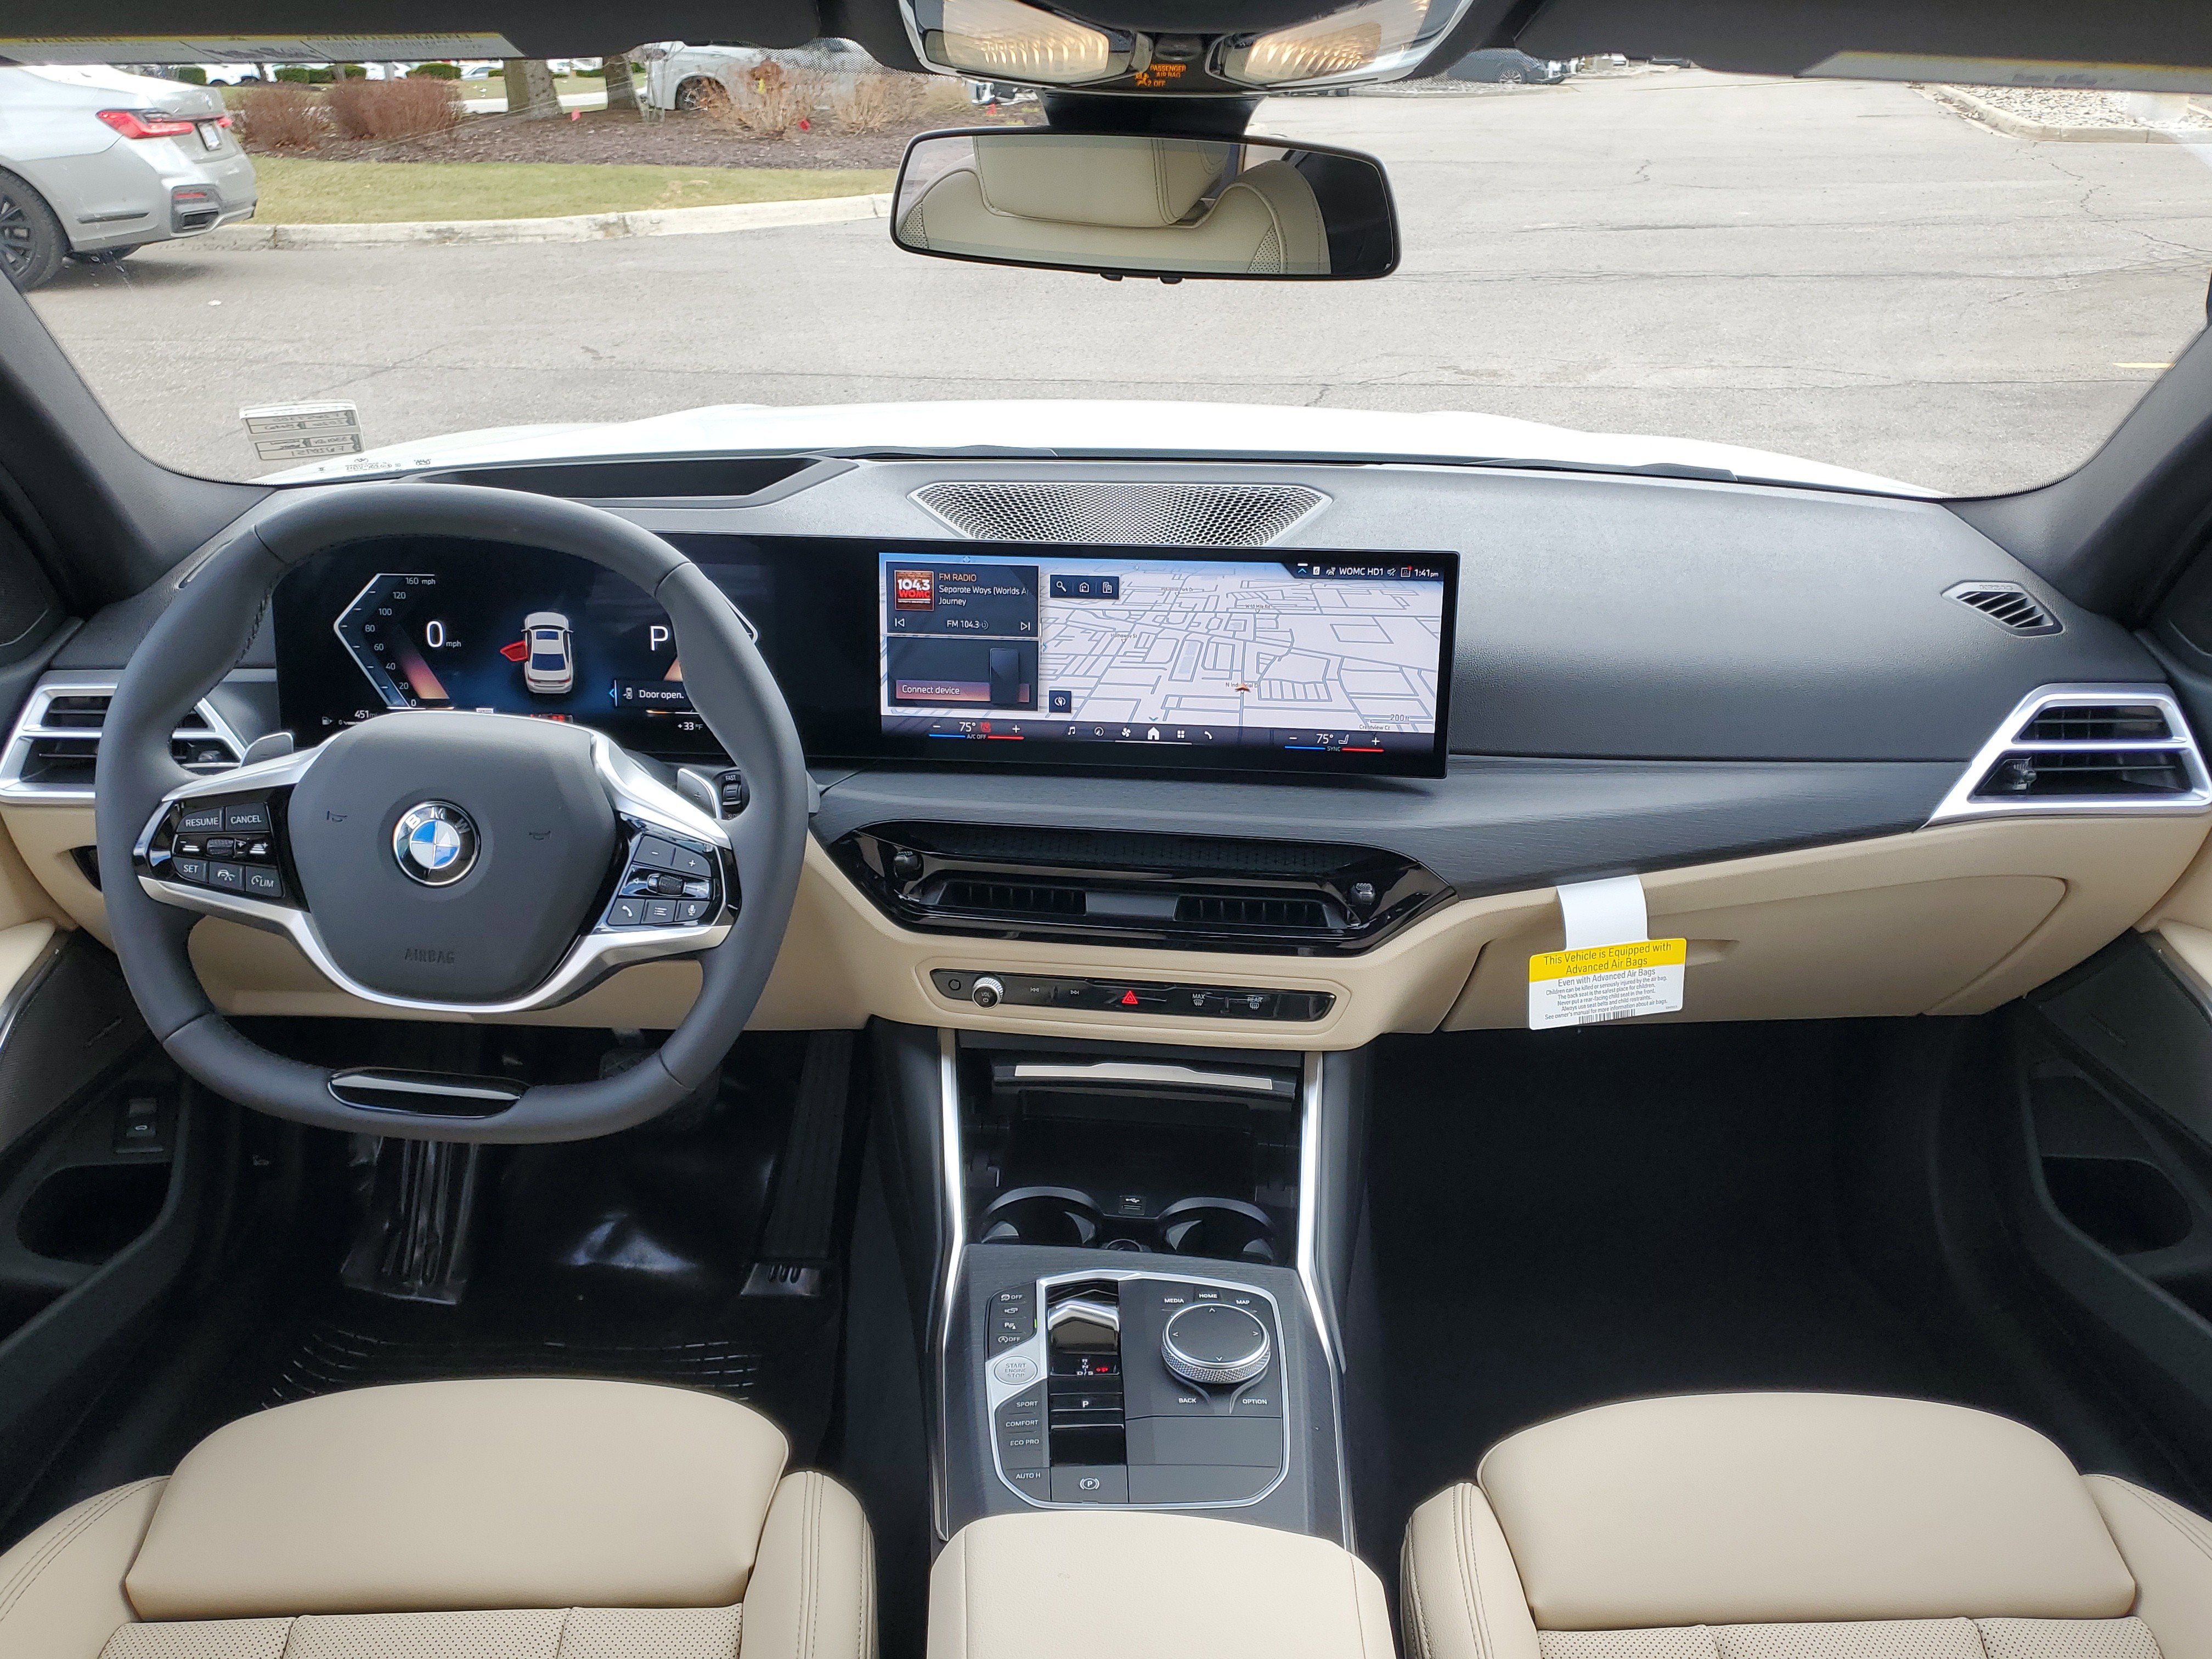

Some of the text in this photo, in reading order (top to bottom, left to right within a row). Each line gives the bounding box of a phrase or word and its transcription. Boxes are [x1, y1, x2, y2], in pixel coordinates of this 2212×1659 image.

[1339, 567, 1383, 576] WOMC HD1
[952, 574, 977, 582] RADIO
[898, 579, 930, 591] 104.3
[898, 589, 930, 598] WOMC
[939, 585, 970, 594] Separate
[972, 586, 992, 595] Ways
[993, 587, 1020, 596] (Worlds
[939, 597, 967, 606] Journey
[960, 620, 979, 629] 104.3
[426, 620, 462, 649] 0 mph
[650, 625, 669, 651] P
[374, 643, 384, 651] 60
[902, 685, 960, 695] Connect device
[639, 690, 684, 701] Door open.
[411, 698, 417, 707] 0
[354, 710, 369, 719] 451
[959, 721, 977, 732] 75°
[1316, 733, 1334, 744] 75°
[185, 815, 262, 827] RESUME CANCEL
[405, 806, 471, 834] BMW
[183, 864, 199, 873] SET
[259, 878, 274, 888] LIM
[404, 948, 455, 963] AIRBAG
[1544, 942, 1671, 966] This Vehicle is Equipped with
[1566, 957, 1647, 975] Advanced Air Bags
[1558, 968, 1656, 987] Even with Advanced Air Bags
[1600, 980, 1620, 988] seriously
[1610, 1002, 1635, 1011] information
